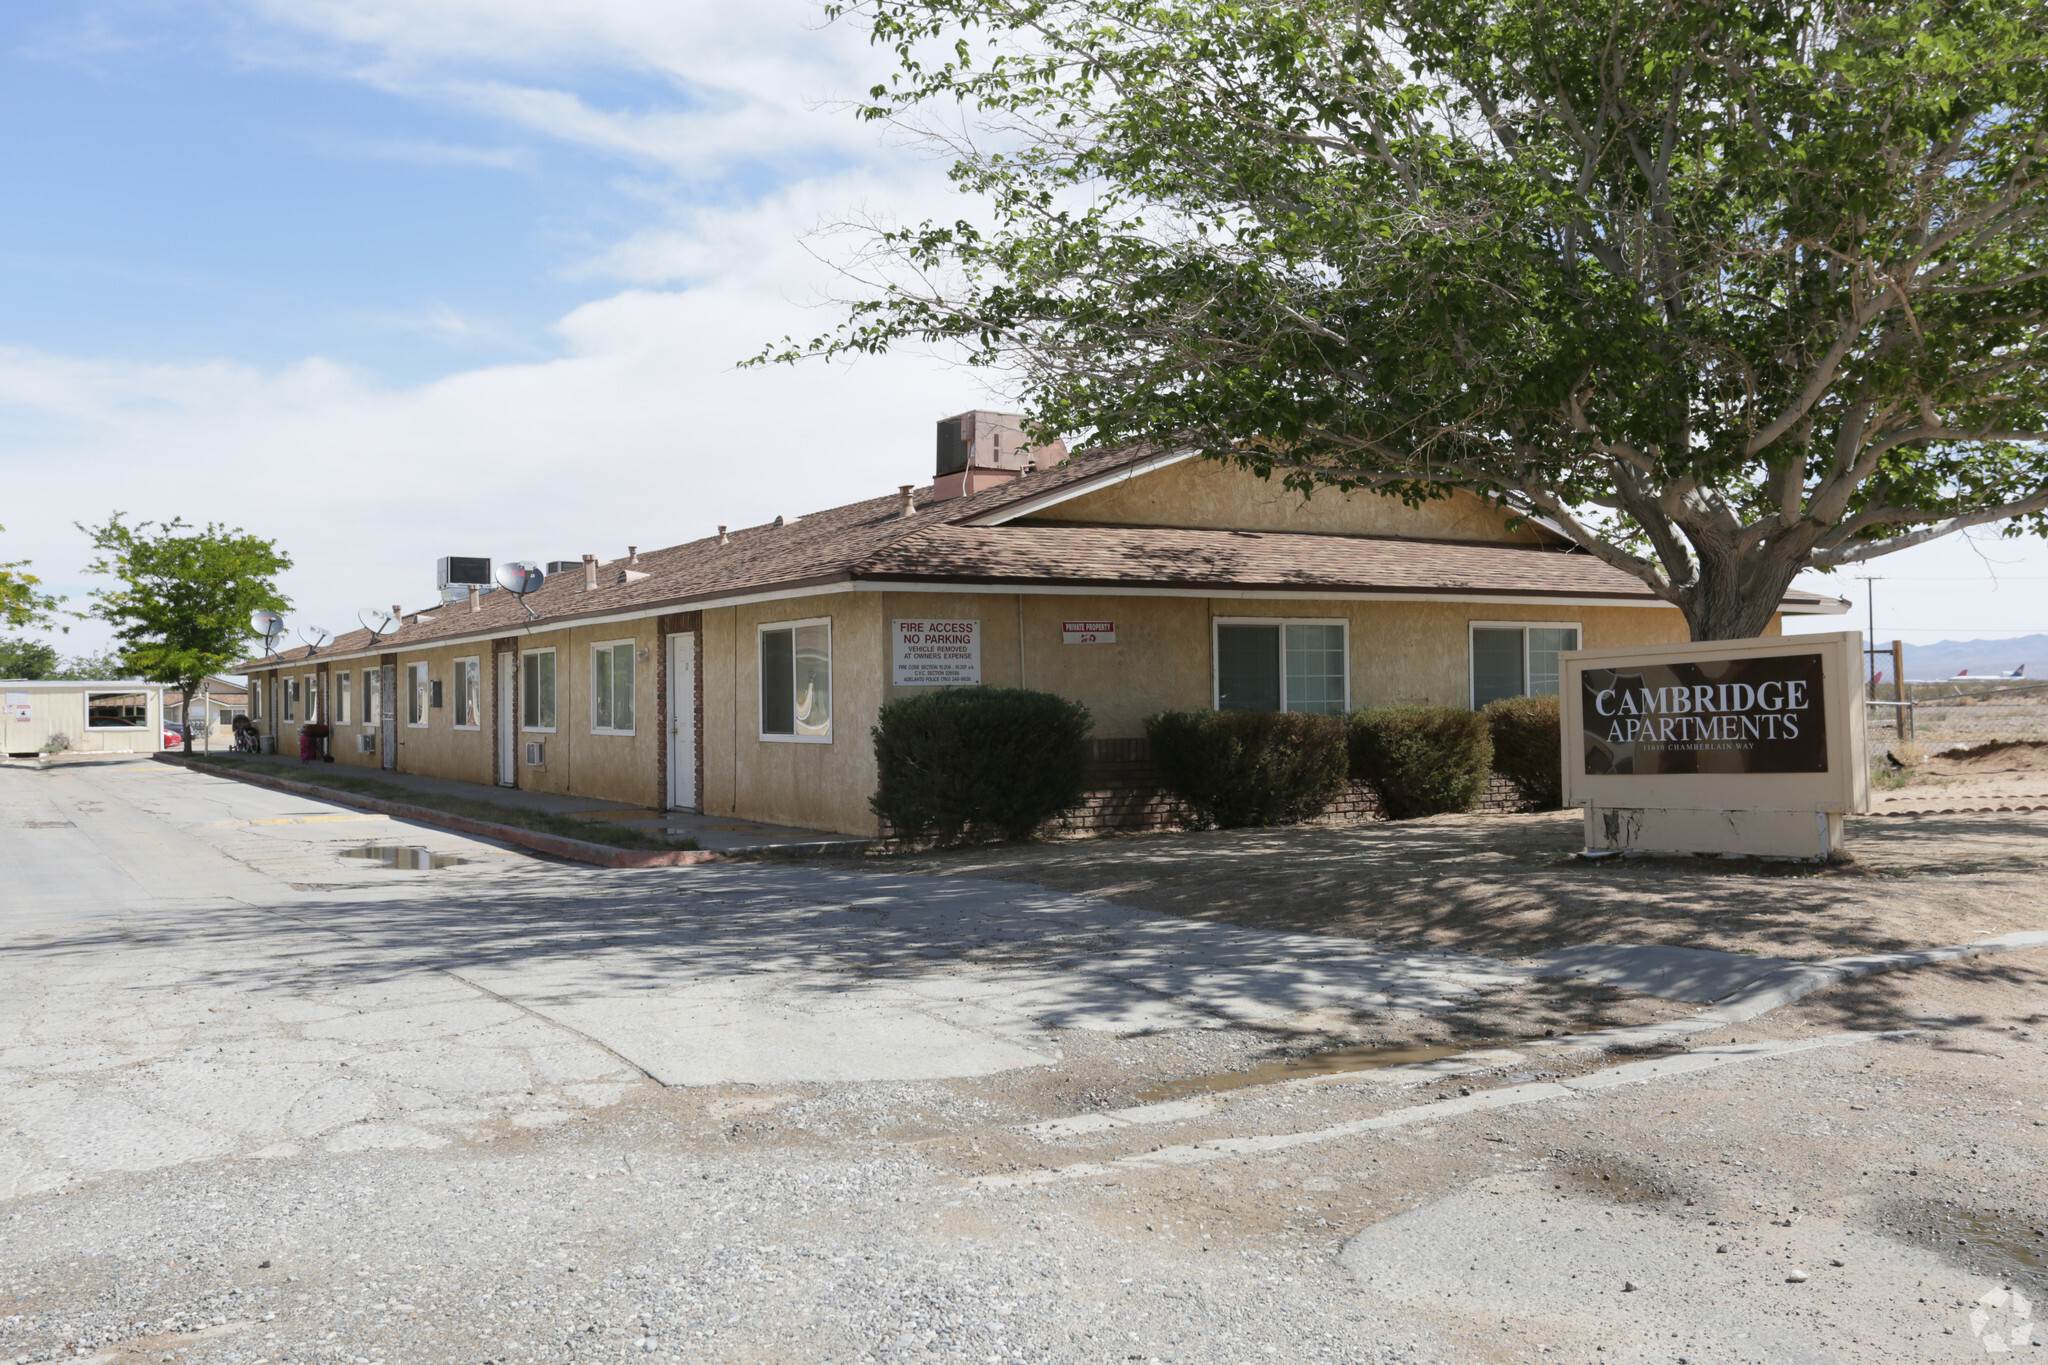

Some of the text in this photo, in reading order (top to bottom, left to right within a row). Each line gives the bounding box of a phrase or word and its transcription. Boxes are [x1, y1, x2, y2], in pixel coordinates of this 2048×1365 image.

[900, 622, 973, 633] FIRE ACCESS
[904, 634, 970, 644] NO PARKING
[1595, 680, 1810, 716] CAMBRIDGE
[1606, 713, 1799, 743] APARTMENTS
[1668, 743, 1733, 751] CHAMBERLAIN
